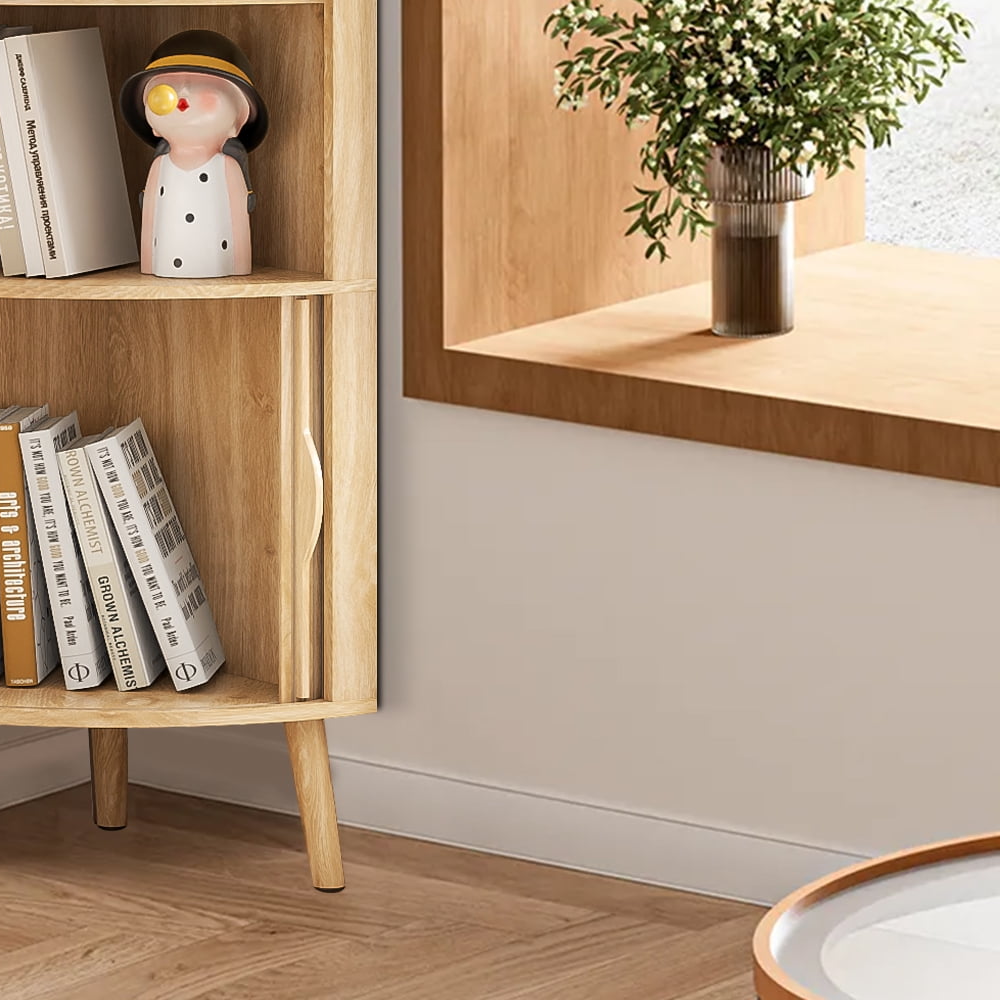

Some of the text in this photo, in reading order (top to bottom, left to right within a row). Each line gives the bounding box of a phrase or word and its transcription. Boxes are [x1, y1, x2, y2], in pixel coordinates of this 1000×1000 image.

[26, 120, 57, 260] Метод управления проектами
[0, 525, 19, 534] &
[65, 450, 85, 486] ROWN
[75, 490, 104, 554] ALCHEMIST
[1, 540, 27, 620] architecture
[146, 576, 160, 592] WANT
[152, 592, 164, 600] TO
[98, 575, 137, 688] GROWN ALCHEMIS
